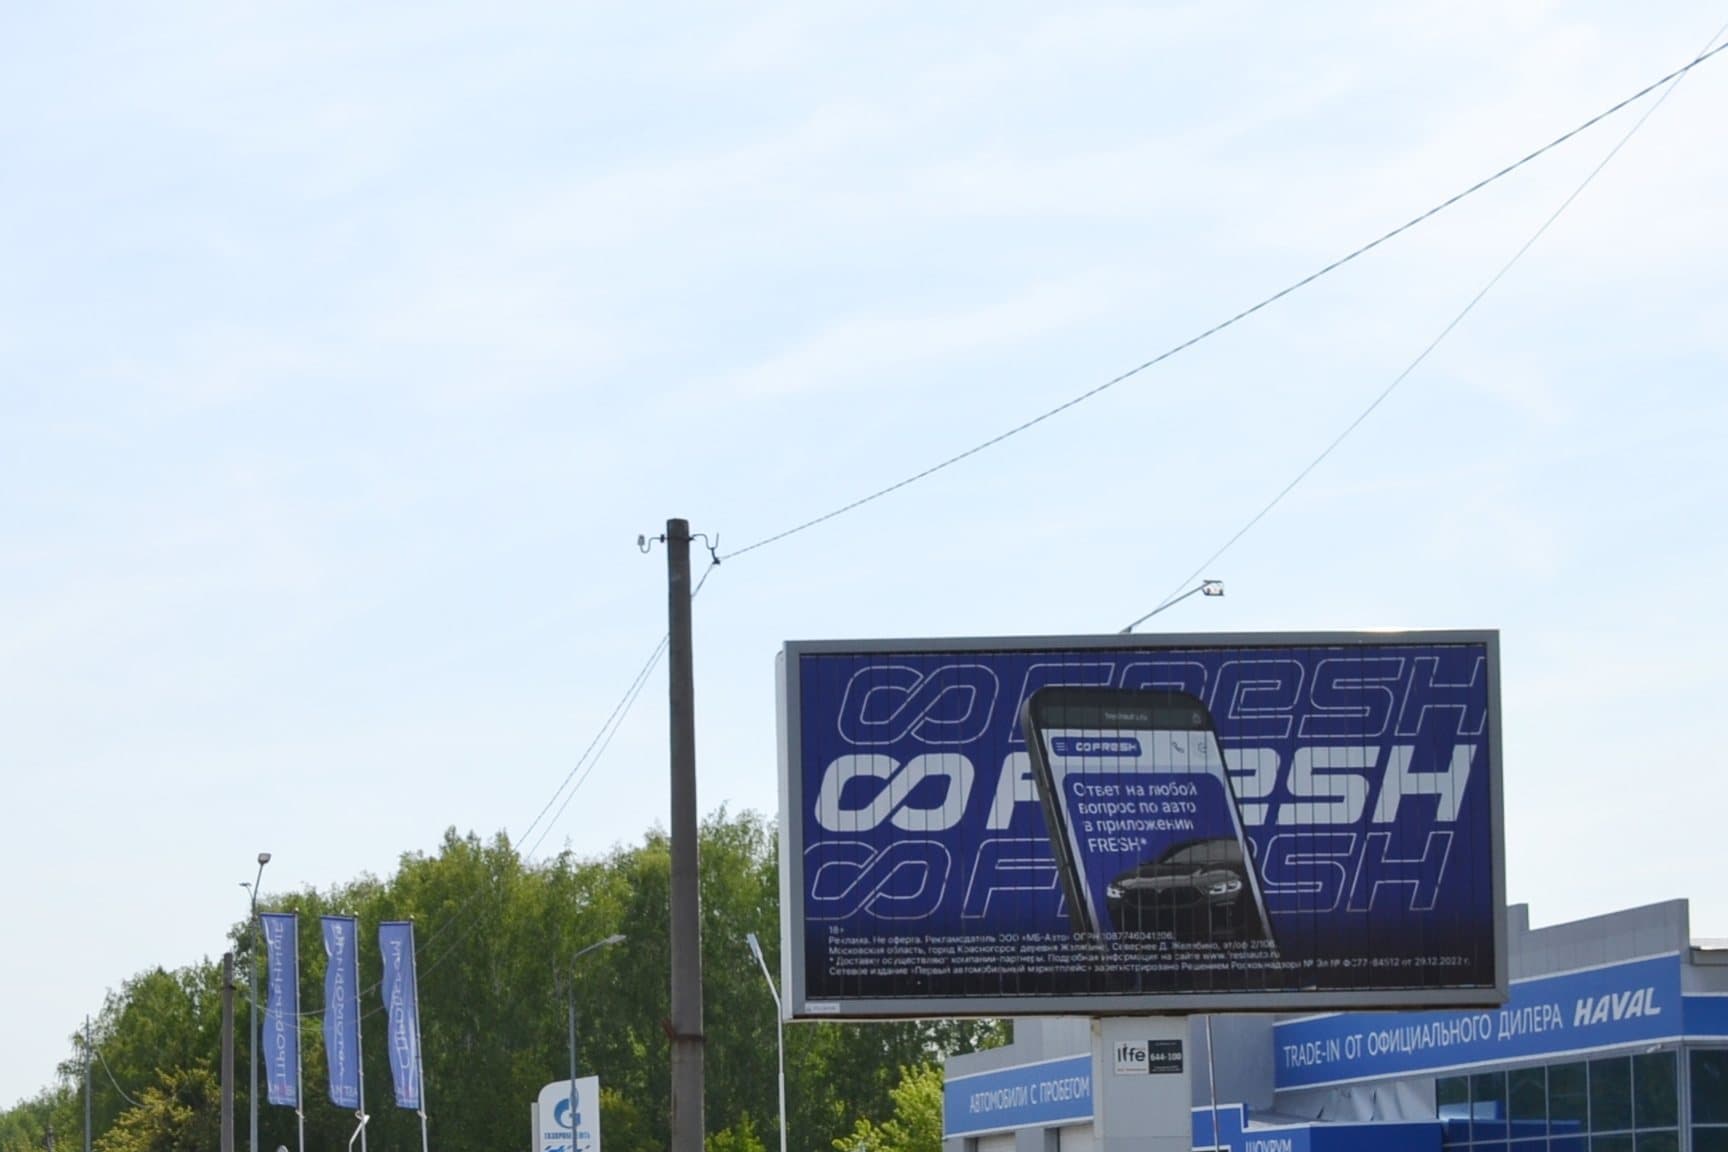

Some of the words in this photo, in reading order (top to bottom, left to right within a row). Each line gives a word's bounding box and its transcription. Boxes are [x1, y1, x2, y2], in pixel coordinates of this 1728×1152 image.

[1073, 782, 1120, 797] Ответ
[1126, 784, 1145, 796] на
[1149, 781, 1198, 796] любой
[1079, 801, 1136, 817] вопрос
[1139, 802, 1158, 814] по
[1162, 801, 1197, 813] авто
[1084, 821, 1093, 832] в
[1097, 819, 1194, 835] приложении
[1283, 1037, 1341, 1069] TRADE-IN
[1345, 1034, 1363, 1059] ОТ
[1367, 1016, 1492, 1056] ОФИЦИАЛЬНОГО
[1498, 1003, 1564, 1041] ДИЛЕРА
[1573, 987, 1662, 1027] HAVAL
[969, 1085, 1027, 1114] АВТОМОБИЛИ
[1030, 1083, 1038, 1104] С
[1039, 1076, 1091, 1104] ПРОБЕГОМ
